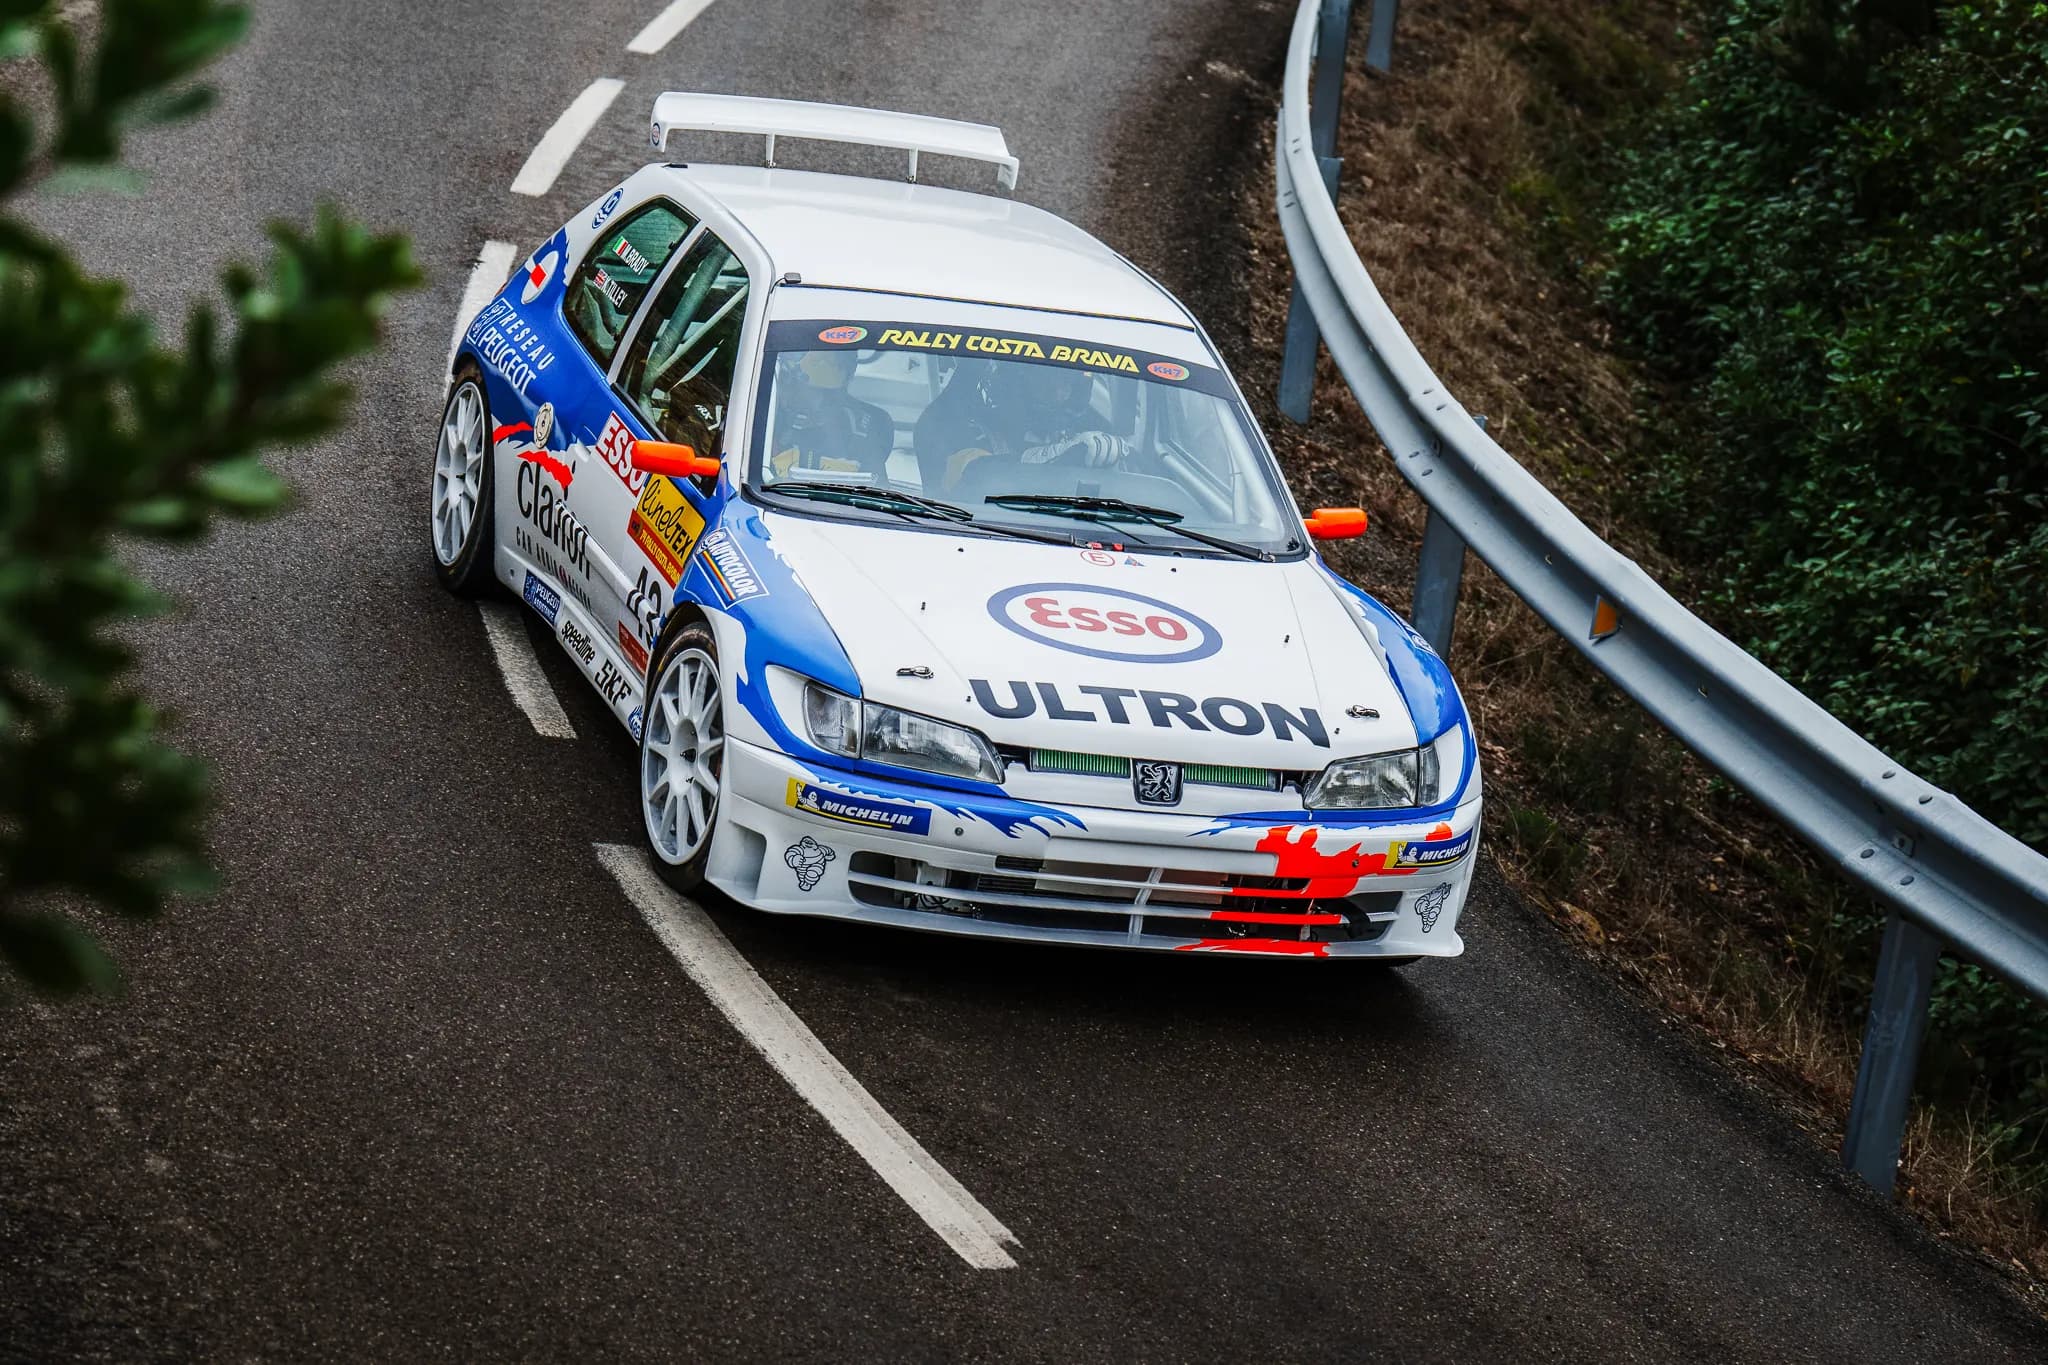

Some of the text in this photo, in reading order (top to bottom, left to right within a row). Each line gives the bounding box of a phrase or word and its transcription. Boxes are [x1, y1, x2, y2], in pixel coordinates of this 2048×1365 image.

[478, 326, 537, 396] PEUGEOT
[499, 311, 555, 370] RESEAU
[878, 329, 1140, 373] RALLY COSTA BRAVA
[708, 541, 759, 597] AUTOCOLOR
[562, 620, 596, 666] speedline
[595, 658, 632, 706] SKF
[969, 679, 1331, 748] ULTRON
[821, 800, 913, 825] MICHELIN
[1419, 839, 1469, 861] MICHELIN
